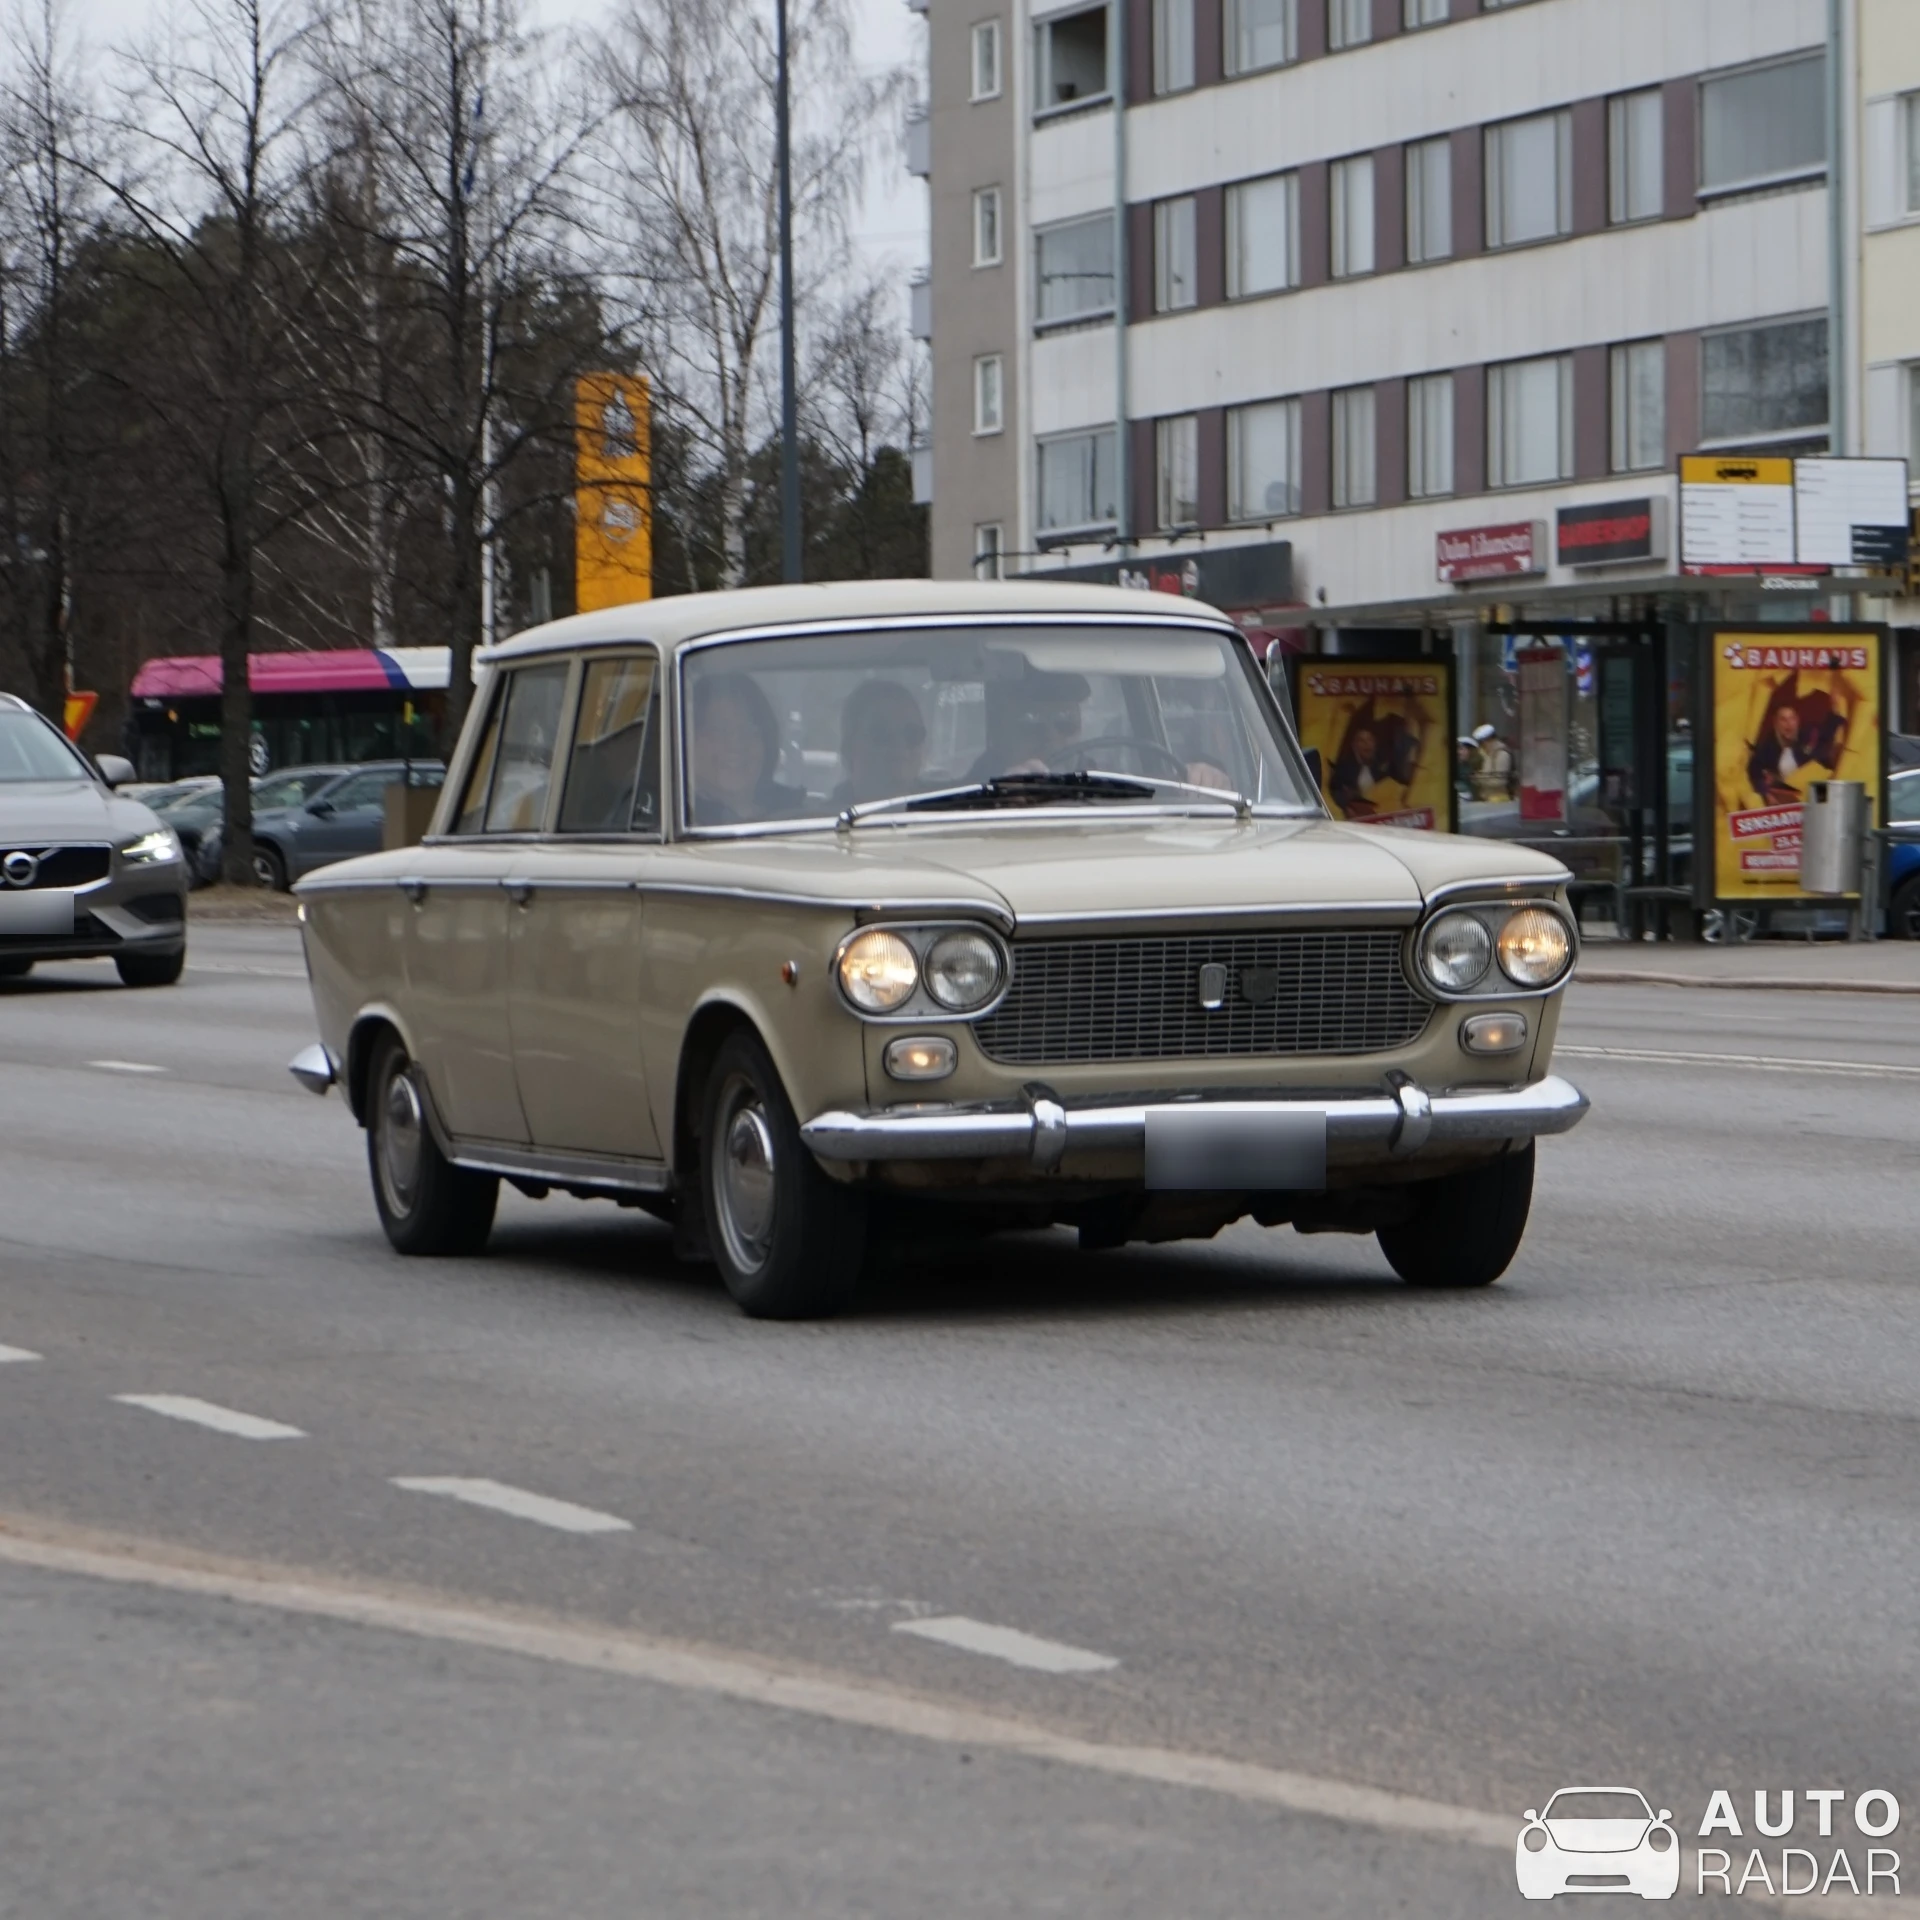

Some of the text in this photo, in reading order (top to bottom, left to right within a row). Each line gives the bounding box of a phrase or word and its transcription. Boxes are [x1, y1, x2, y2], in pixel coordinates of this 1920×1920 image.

[1760, 577, 1819, 590] JCDecaux
[1747, 649, 1867, 667] BAUHAUS
[1737, 811, 1804, 833] SENSAATI
